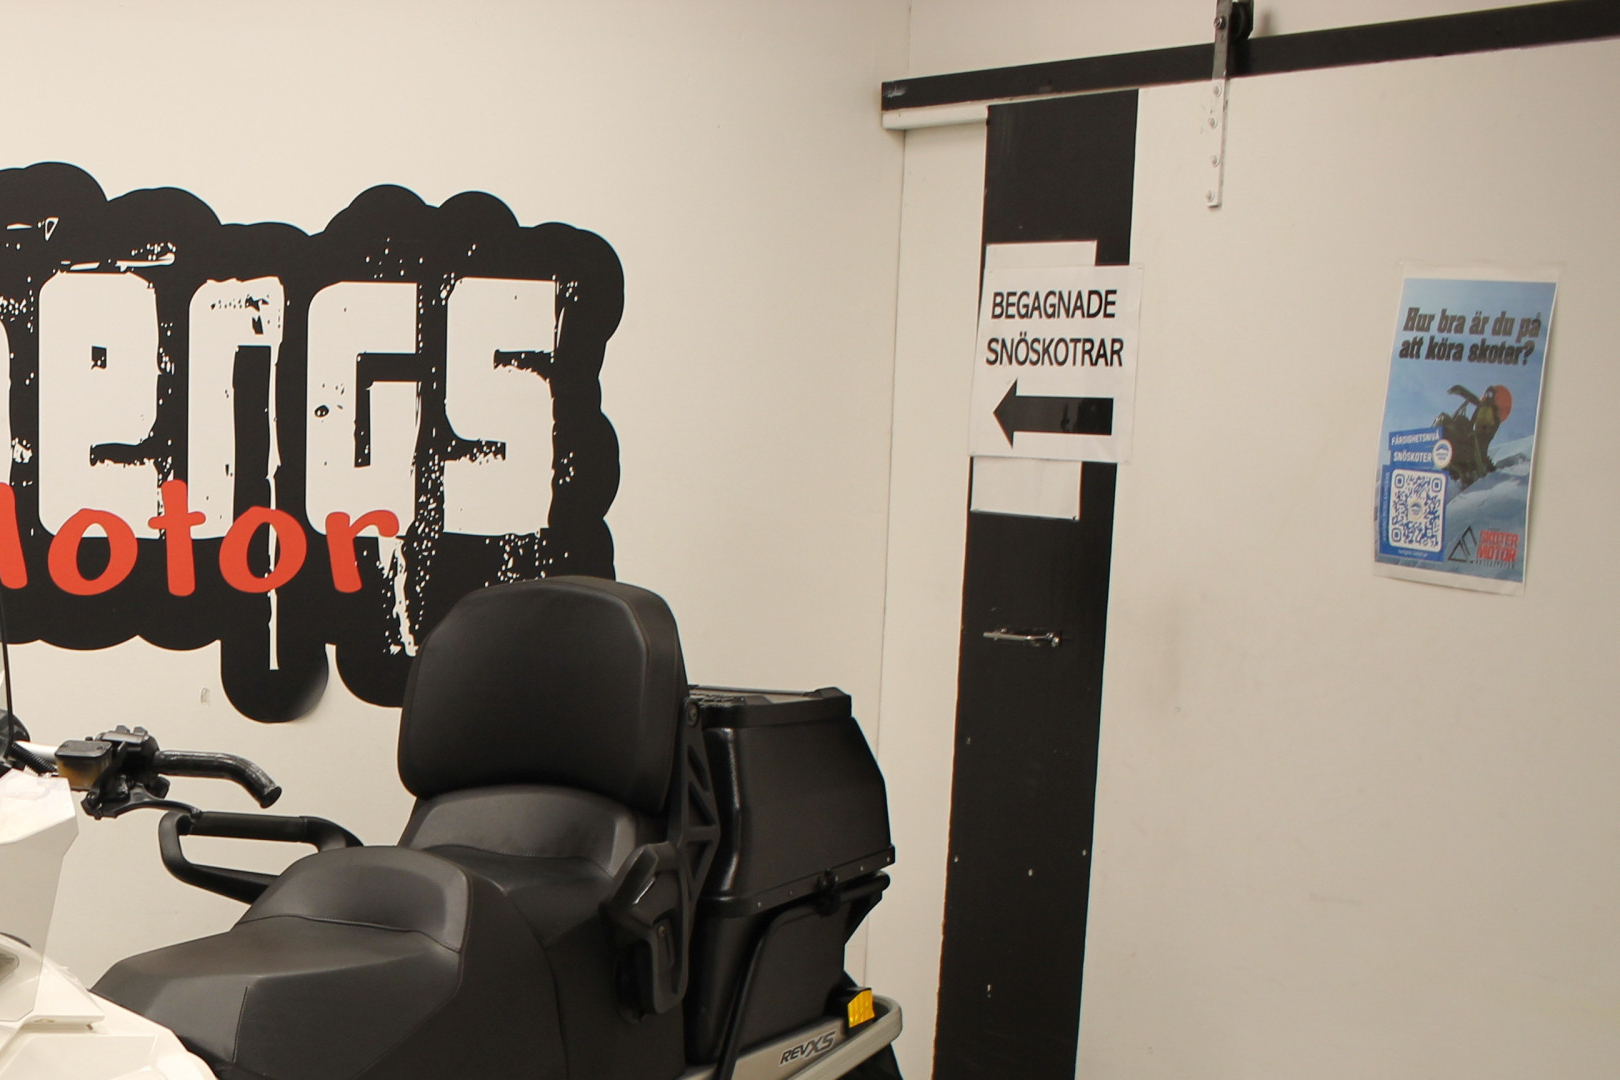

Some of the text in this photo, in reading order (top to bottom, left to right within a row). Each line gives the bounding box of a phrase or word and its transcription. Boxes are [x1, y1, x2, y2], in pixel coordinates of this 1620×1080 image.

[991, 289, 1117, 320] BEGAGNADE
[1402, 306, 1542, 344] Hur bra är du på
[985, 331, 1124, 367] SNÖSKOTRAR
[1398, 335, 1535, 366] att köra skoter?
[1393, 449, 1432, 462] SNÖSKOTER
